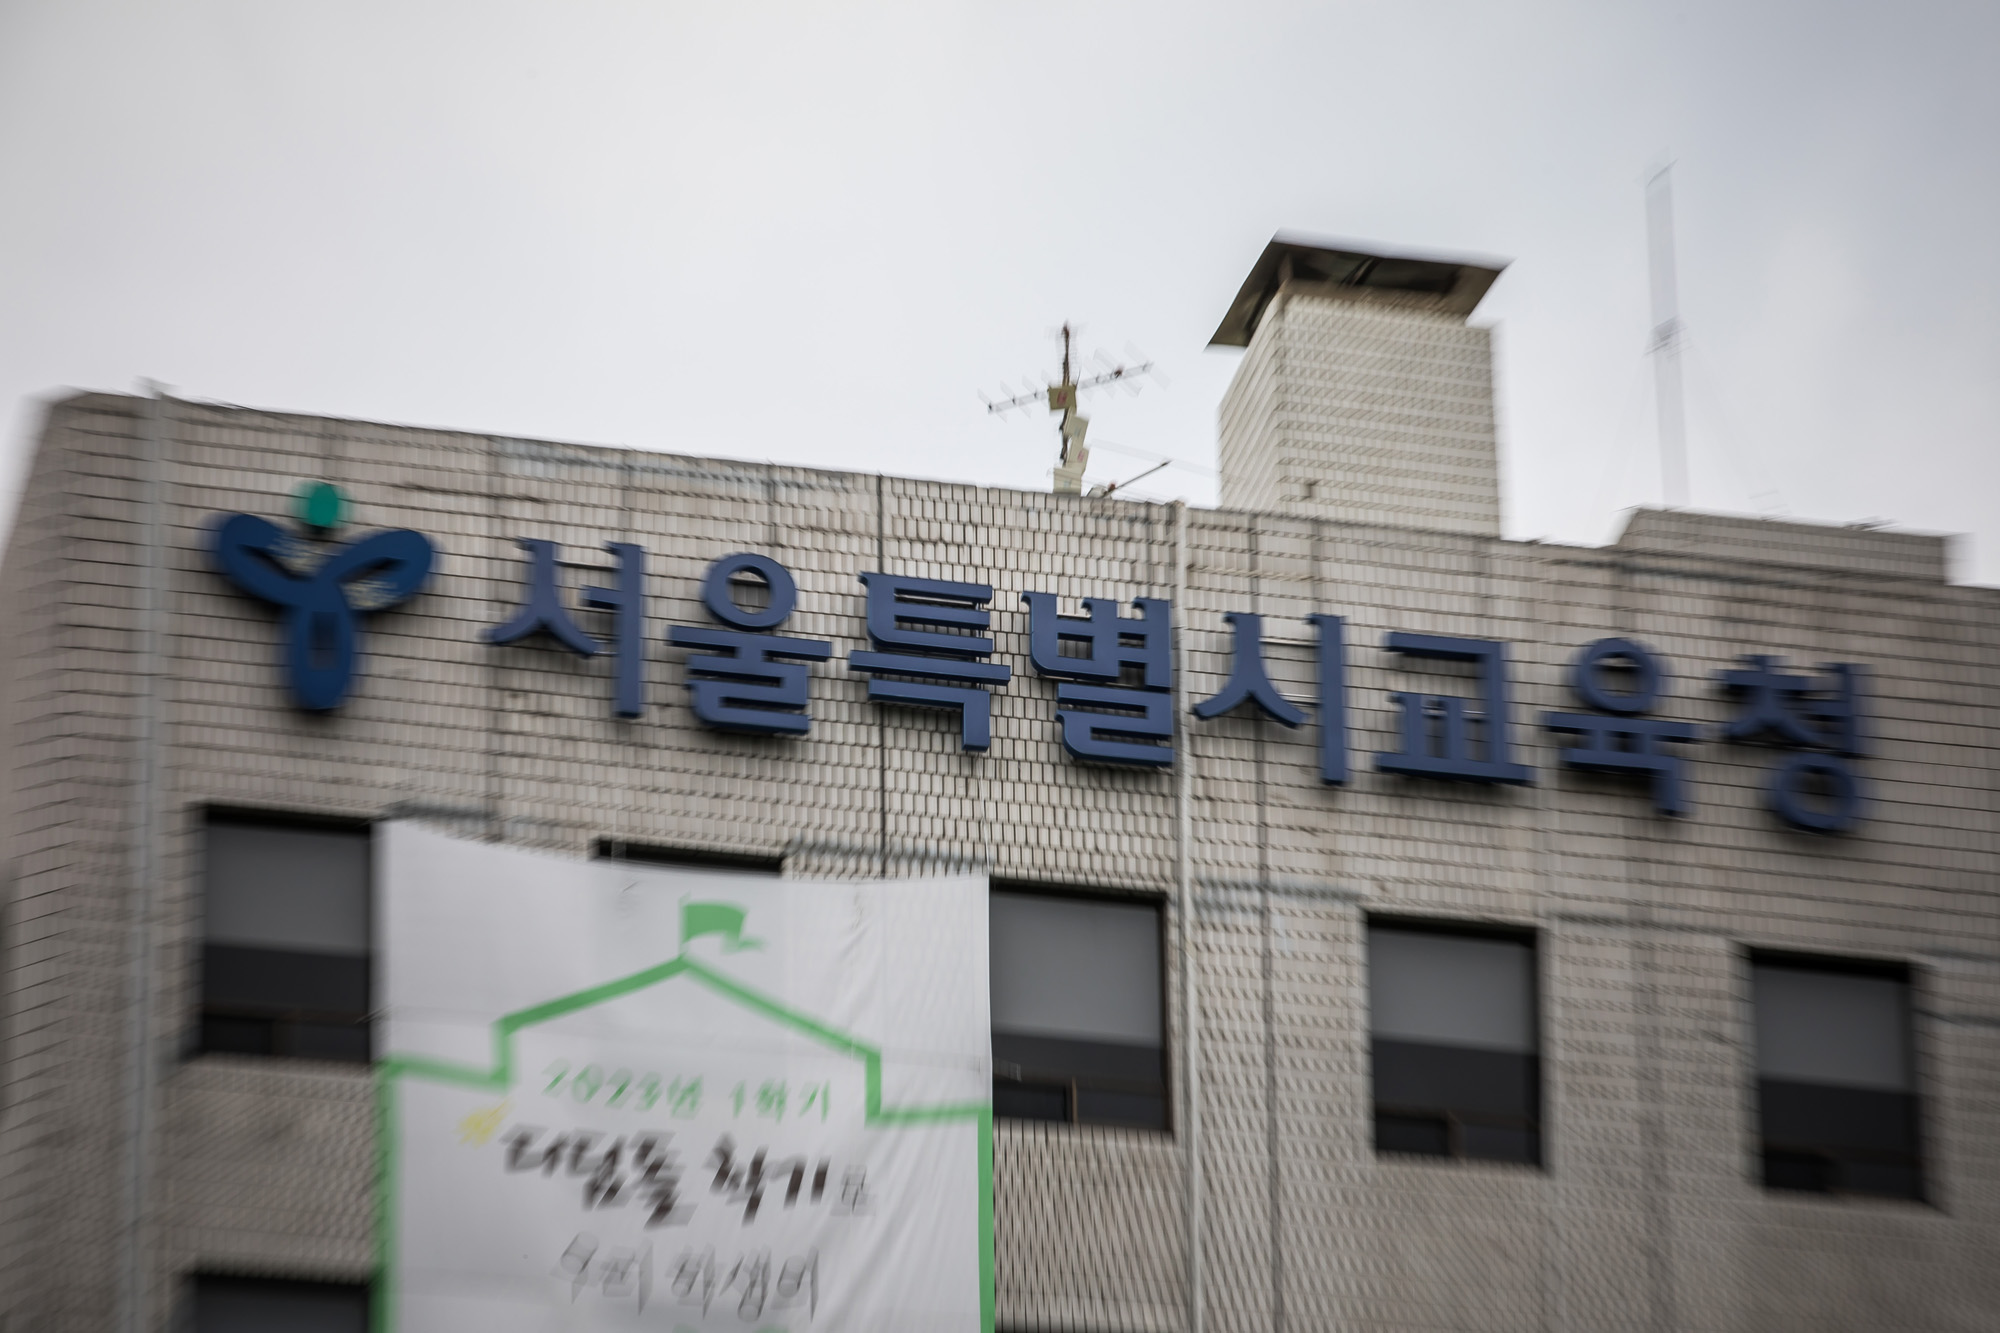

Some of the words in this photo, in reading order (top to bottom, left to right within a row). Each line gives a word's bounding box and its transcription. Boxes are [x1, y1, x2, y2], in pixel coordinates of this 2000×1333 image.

[480, 536, 1872, 833] 서울특별시교육청
[541, 1058, 706, 1120] 2023년
[729, 1077, 832, 1124] 1학기
[550, 1231, 654, 1315] 우리
